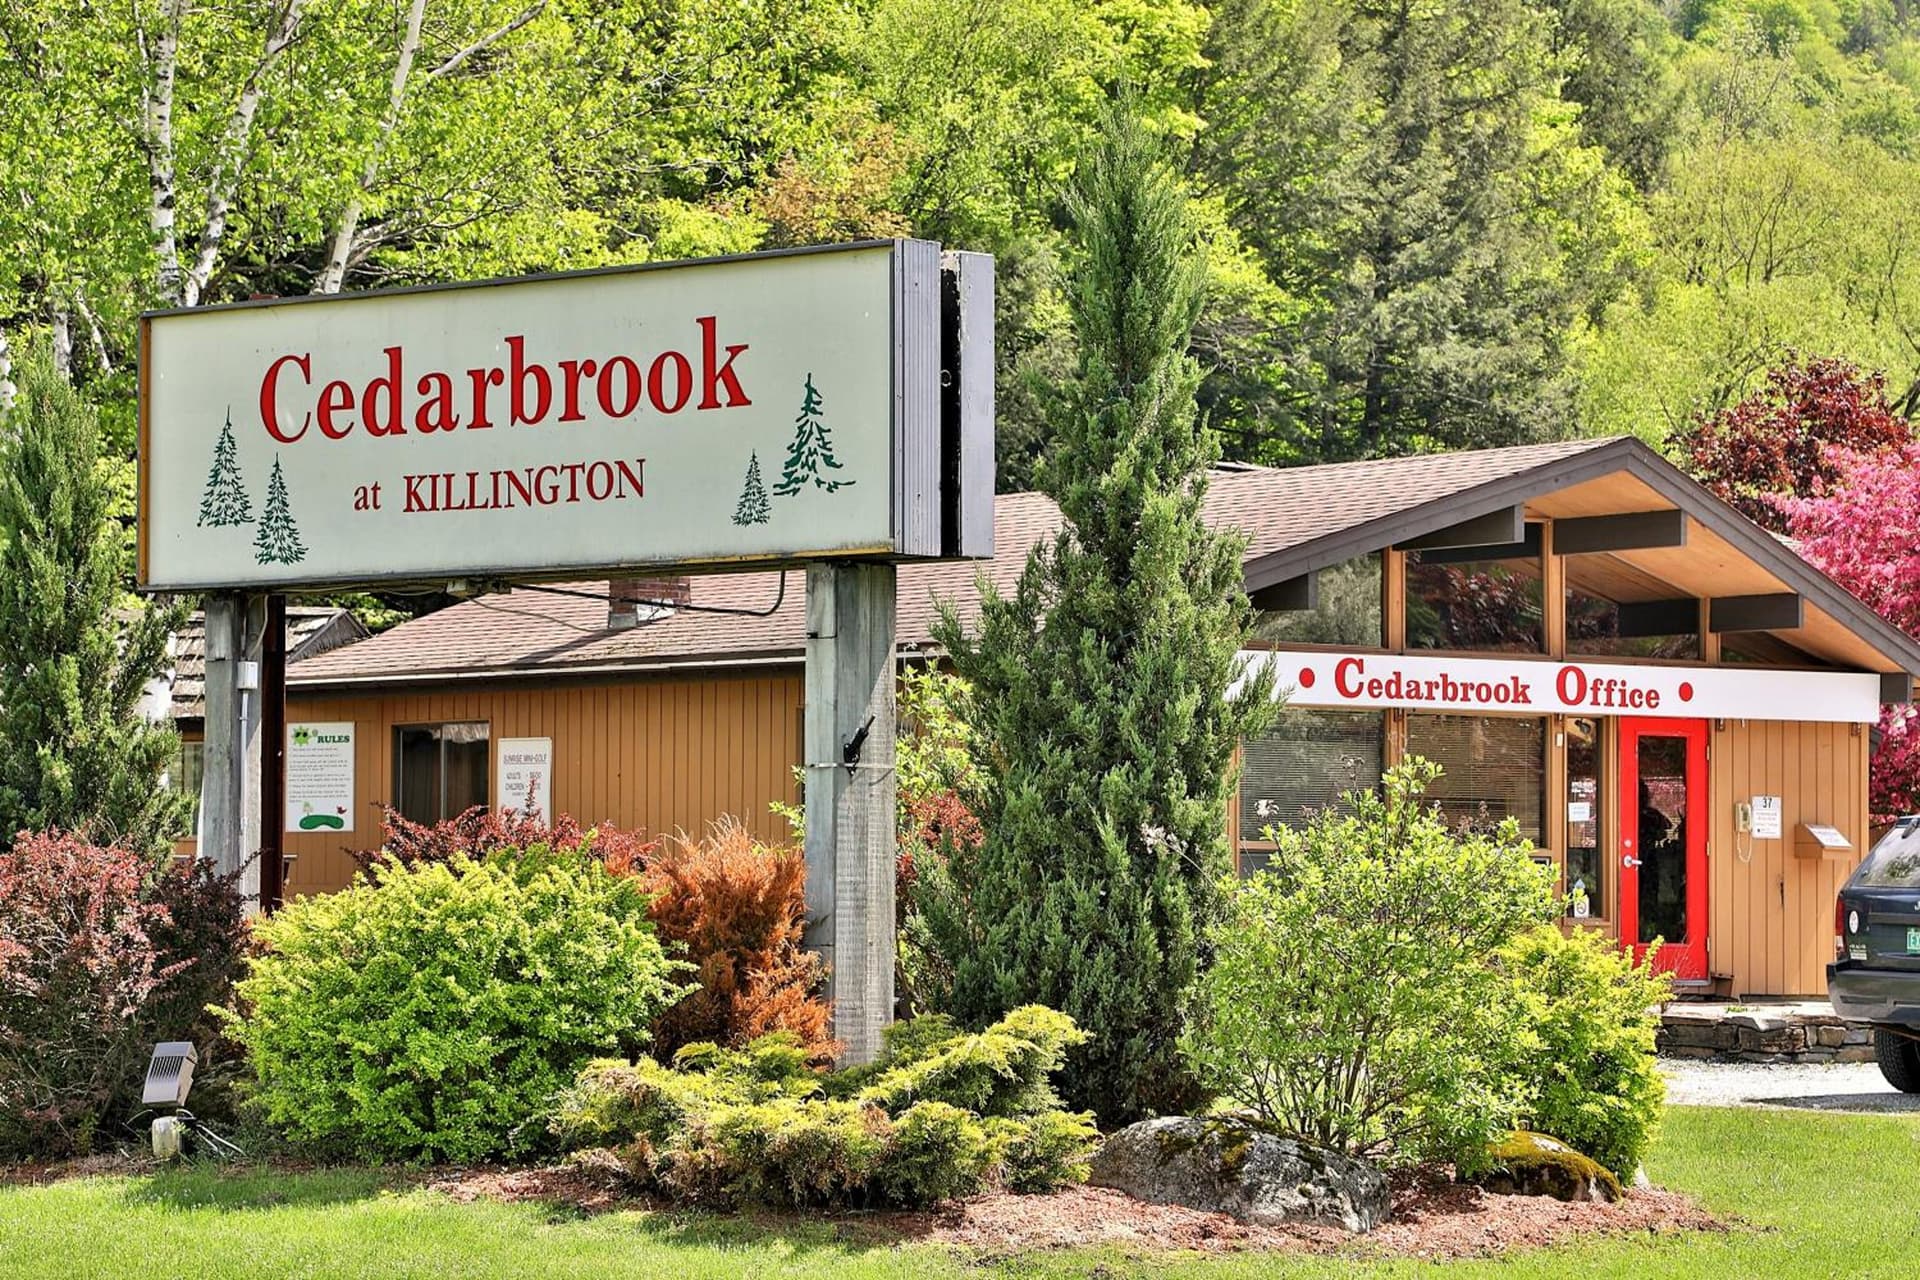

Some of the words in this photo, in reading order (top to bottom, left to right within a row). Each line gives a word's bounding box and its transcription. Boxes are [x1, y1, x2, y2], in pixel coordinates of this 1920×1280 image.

[260, 316, 752, 443] Cedarbrook
[354, 481, 381, 511] at
[403, 459, 645, 513] KILLINGTON
[1334, 657, 1532, 704] Cedarbrook
[1556, 665, 1661, 708] Office
[317, 735, 350, 744] RULES
[1762, 797, 1773, 809] 37
